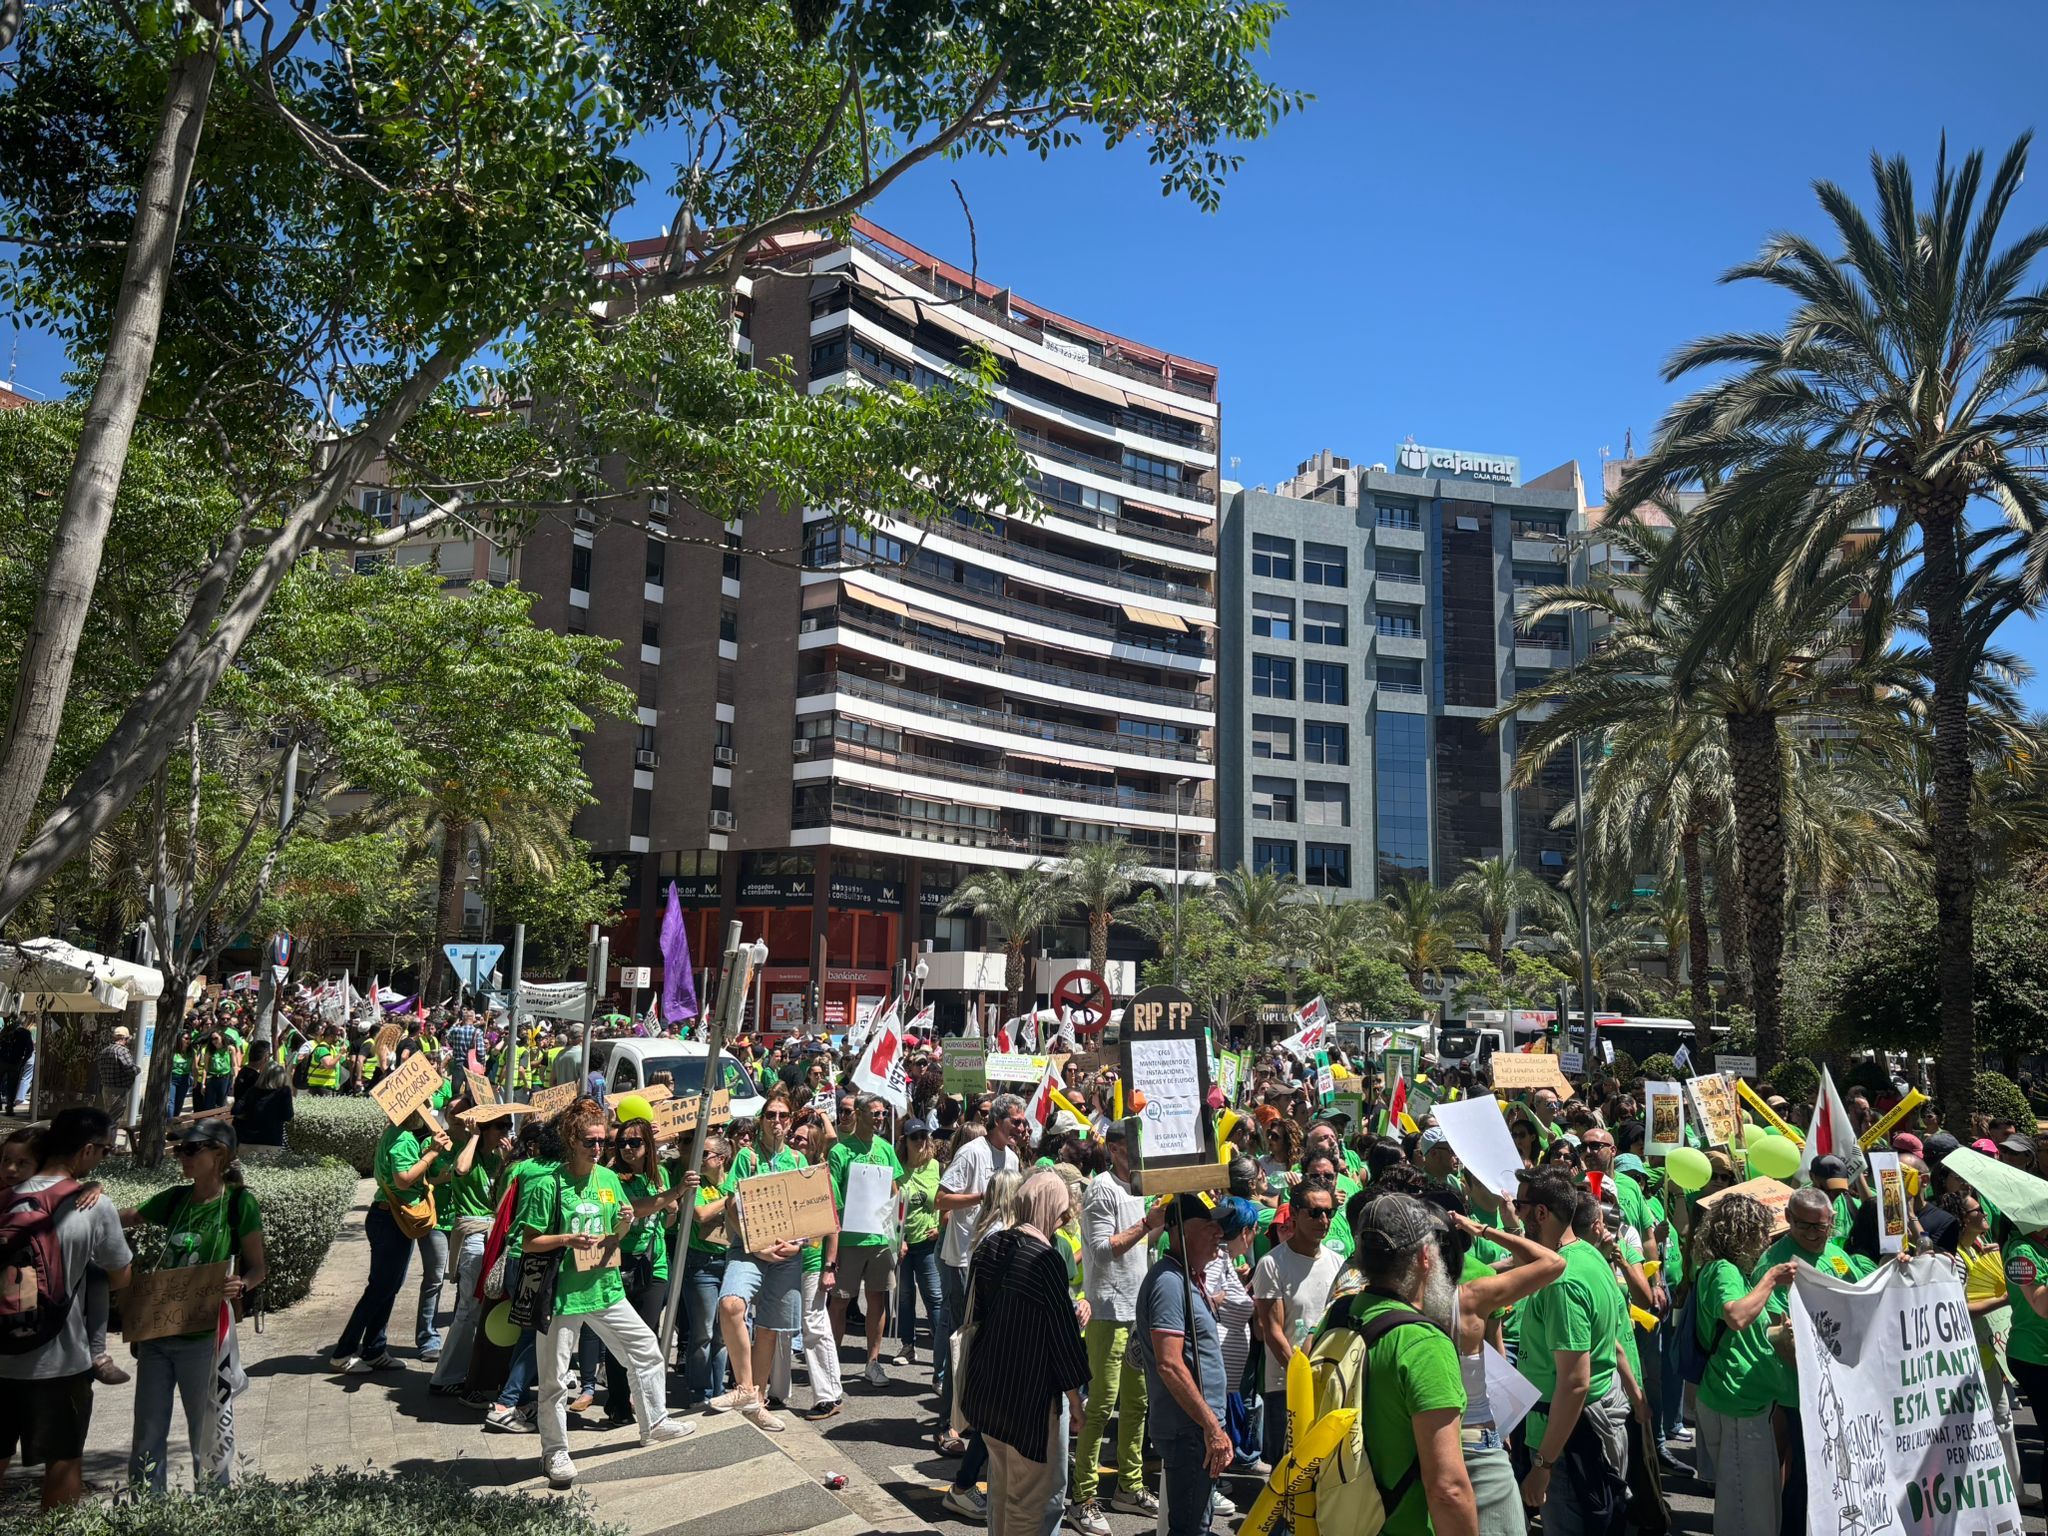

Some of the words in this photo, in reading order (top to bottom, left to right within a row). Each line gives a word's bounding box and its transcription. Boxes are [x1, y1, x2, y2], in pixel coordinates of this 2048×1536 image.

[1431, 452, 1516, 475] cajamar
[1474, 472, 1491, 480] CAJA
[1493, 474, 1513, 482] RURAL
[1134, 1002, 1163, 1031] RIP
[1168, 1002, 1193, 1031] FP
[1160, 1141, 1184, 1149] ALICANTE
[1893, 1383, 1931, 1426] ESTÀ
[1896, 1434, 1911, 1453] PER
[1955, 1422, 1977, 1441] PELS
[1946, 1447, 1965, 1465] PER
